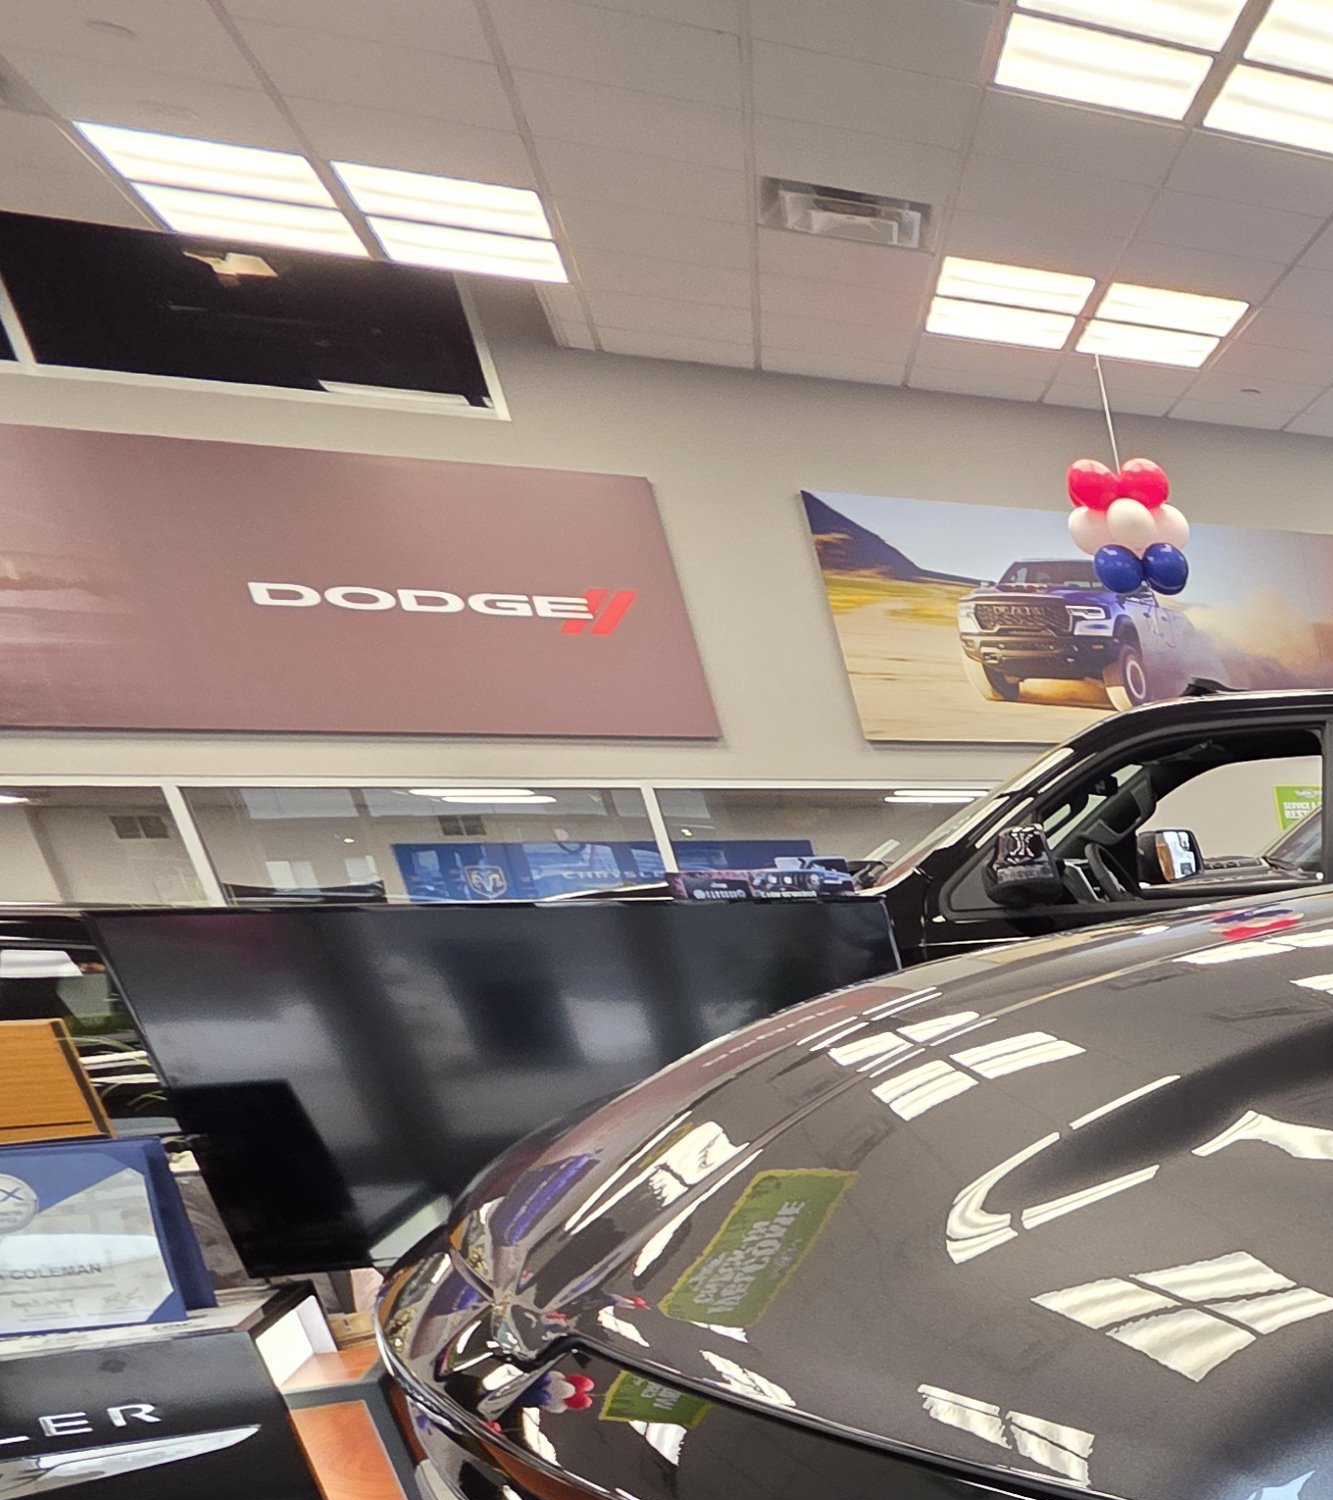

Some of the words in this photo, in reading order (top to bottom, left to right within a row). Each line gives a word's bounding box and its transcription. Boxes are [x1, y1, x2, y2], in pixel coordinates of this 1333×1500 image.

[247, 582, 594, 619] DODGE
[562, 870, 666, 880] CHRYSLE
[10, 1263, 102, 1280] COLEMAN
